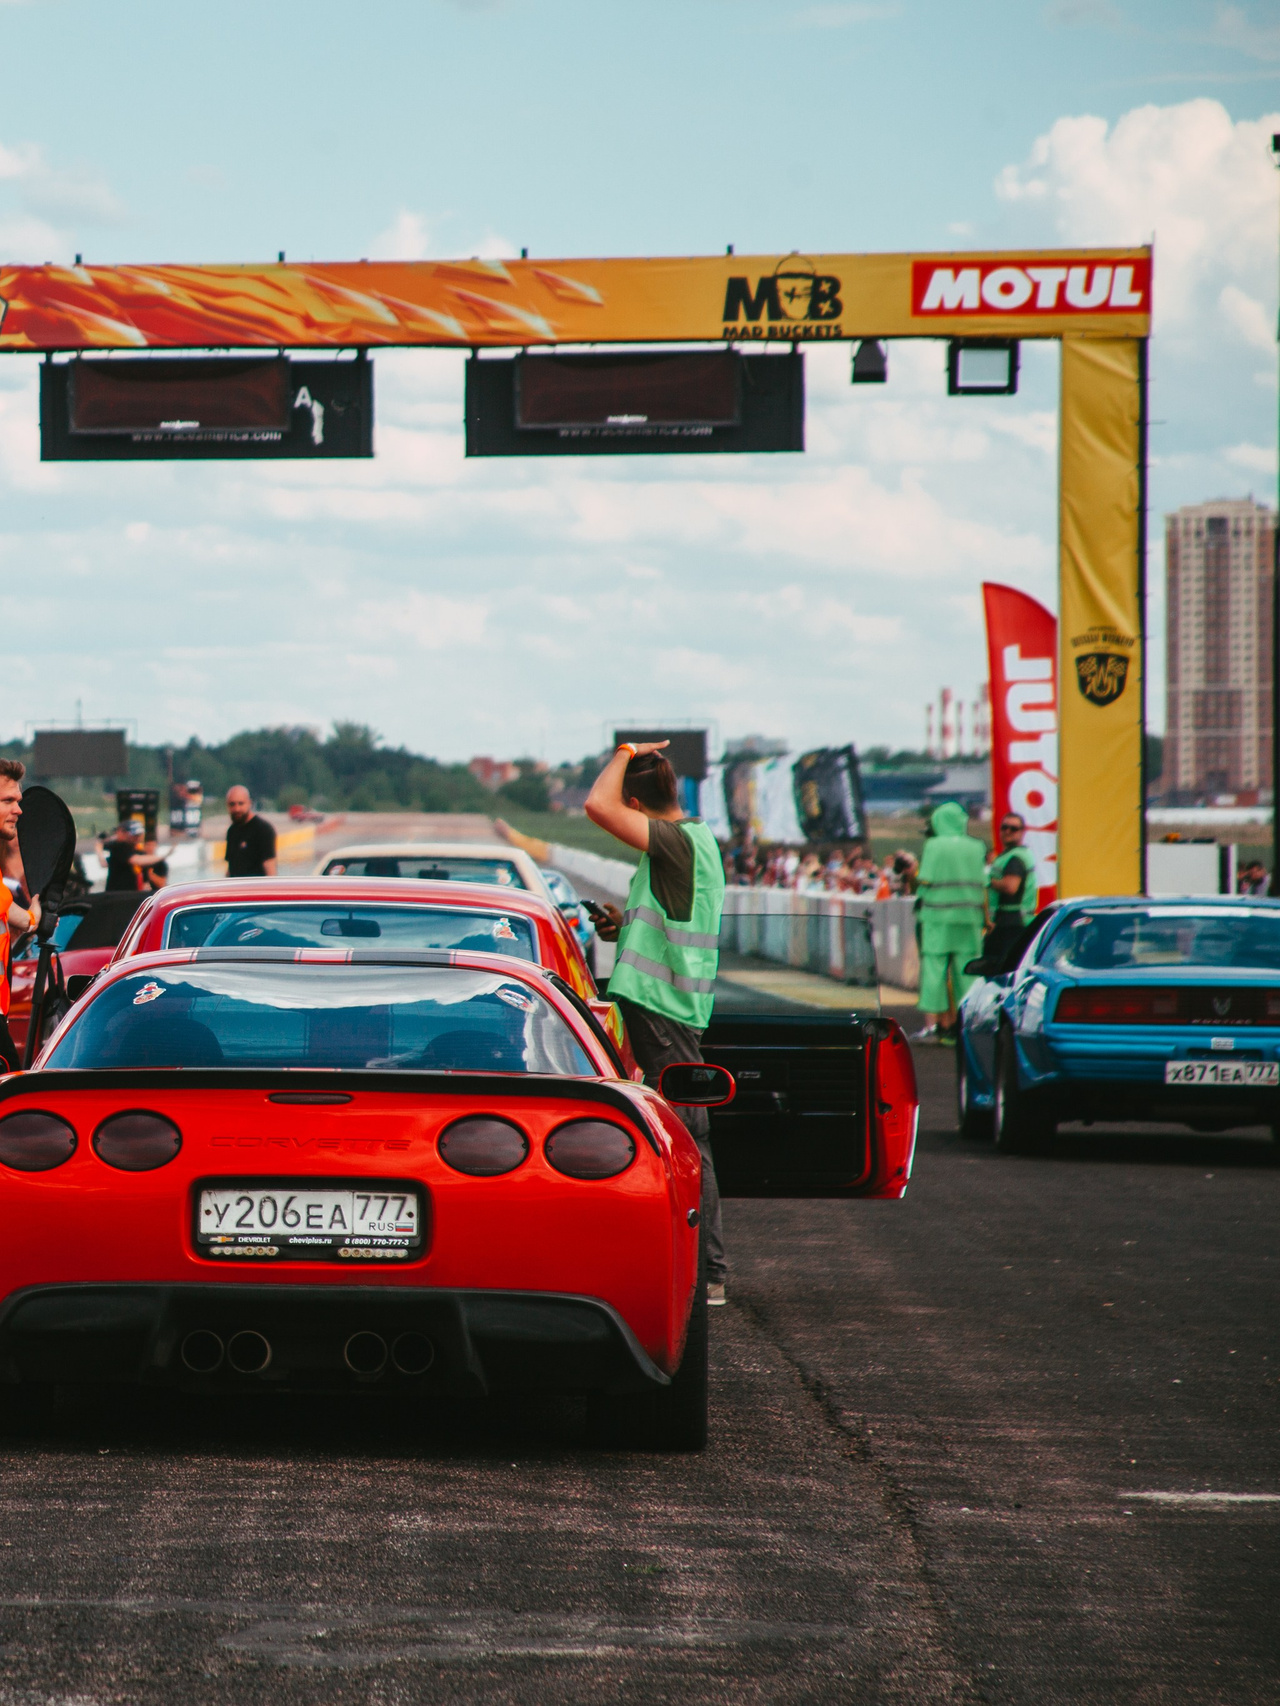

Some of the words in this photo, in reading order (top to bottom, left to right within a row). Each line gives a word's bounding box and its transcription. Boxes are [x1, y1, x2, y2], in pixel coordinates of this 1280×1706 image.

[921, 266, 1143, 310] MOTUL
[723, 326, 763, 338] MAD
[768, 324, 843, 338] BUCKETS
[211, 1136, 412, 1151] CORVETTE
[369, 1221, 394, 1231] RUS
[289, 1236, 332, 1245] cheviplus.ru
[351, 1238, 371, 1246] (800)
